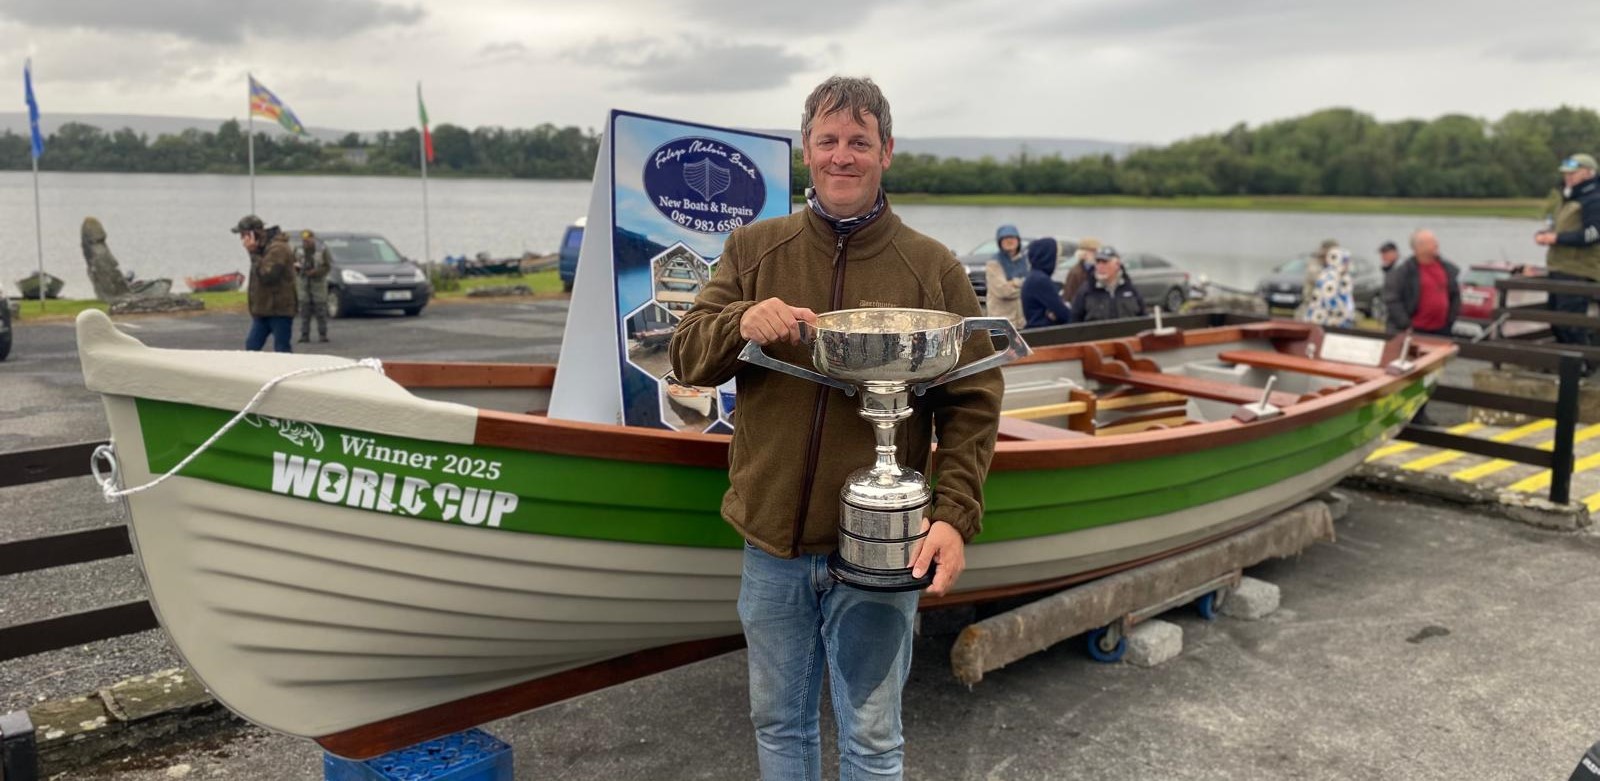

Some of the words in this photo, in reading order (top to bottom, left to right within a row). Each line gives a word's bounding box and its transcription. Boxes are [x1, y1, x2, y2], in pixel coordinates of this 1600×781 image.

[659, 195, 681, 208] New
[683, 198, 708, 212] Boats
[710, 202, 719, 213] &
[720, 203, 753, 217] Repairs
[671, 210, 693, 226] 087
[694, 218, 715, 232] 982
[716, 216, 743, 232] 6580
[341, 433, 438, 470] Winner
[442, 455, 502, 480] 2025
[271, 451, 431, 516] WORLD
[433, 482, 519, 527] CUP
